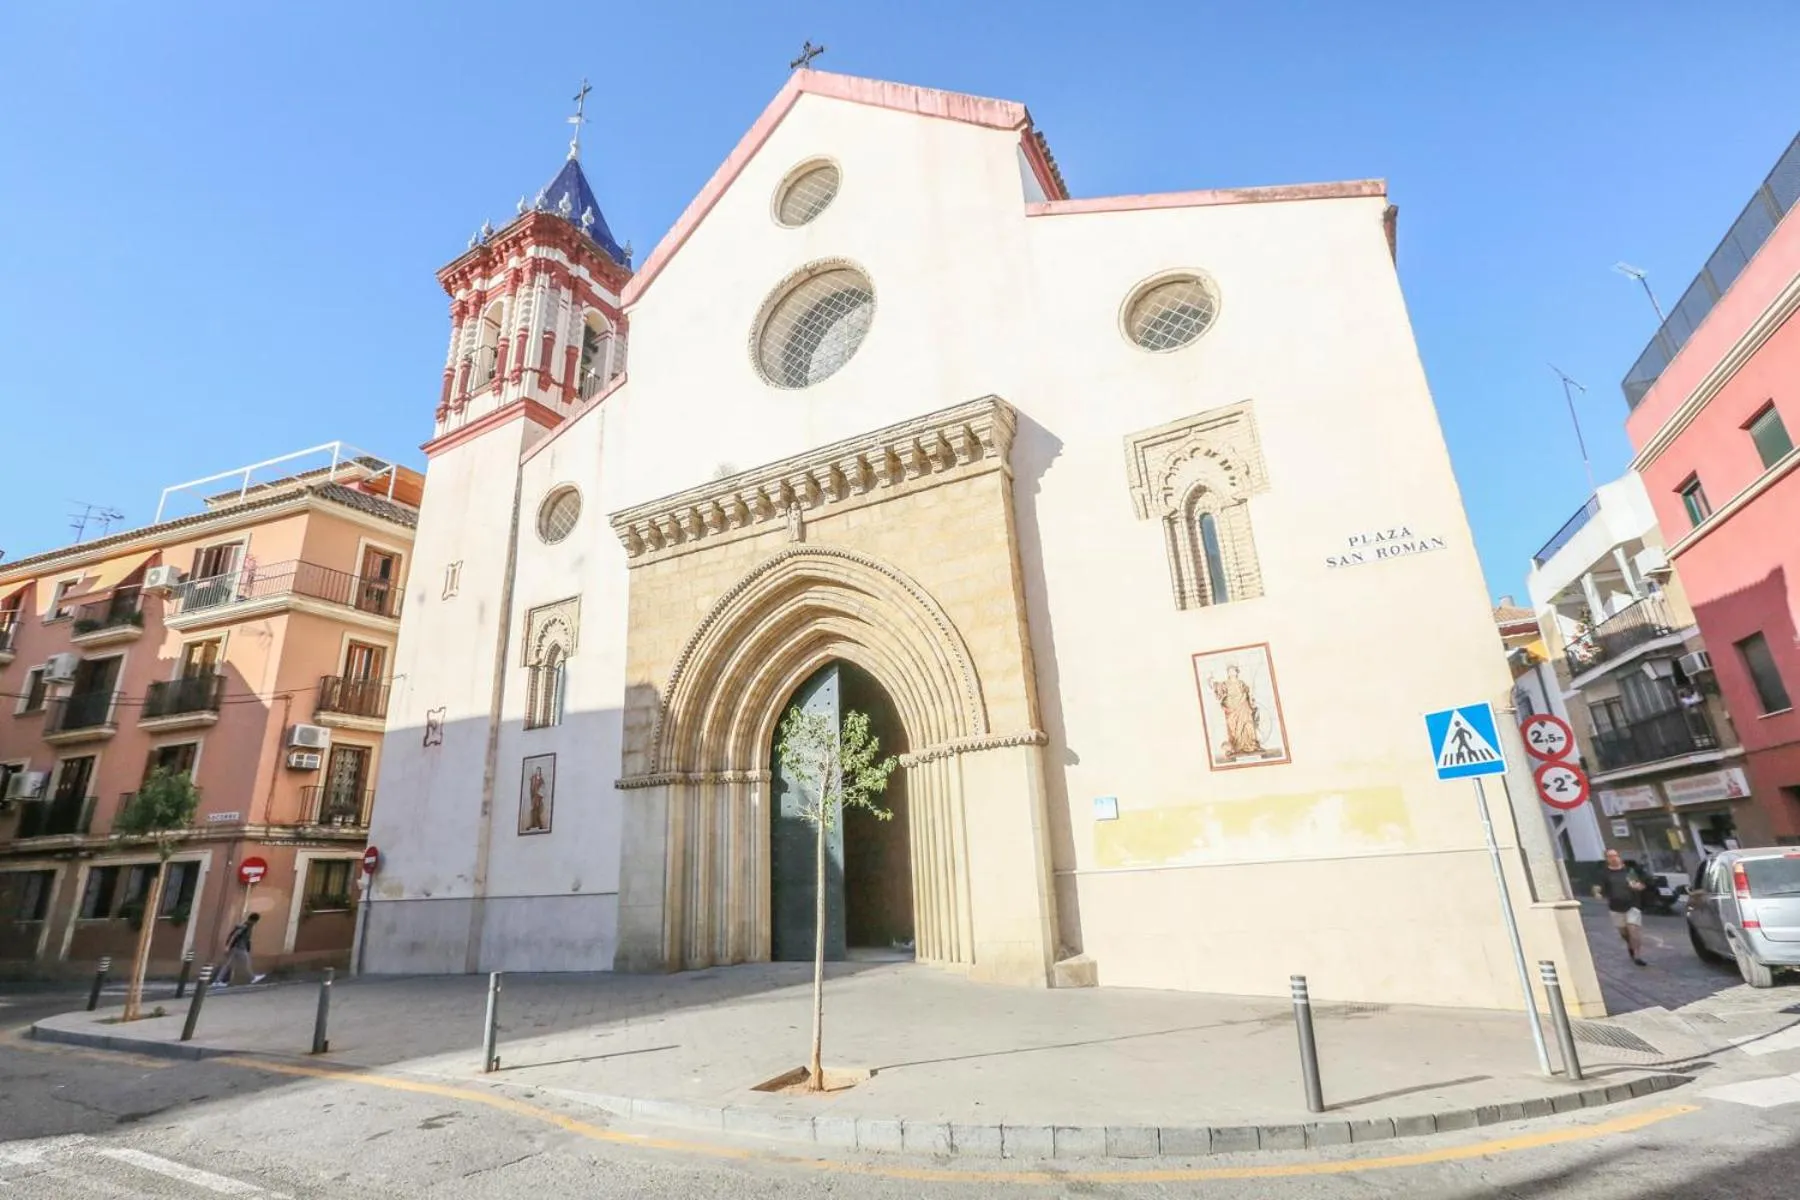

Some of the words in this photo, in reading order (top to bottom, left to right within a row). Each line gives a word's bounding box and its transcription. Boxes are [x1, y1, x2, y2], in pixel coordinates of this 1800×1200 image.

[1348, 526, 1411, 547] PLAZA
[1326, 551, 1364, 568] SAN
[1376, 537, 1444, 559] ROMAN
